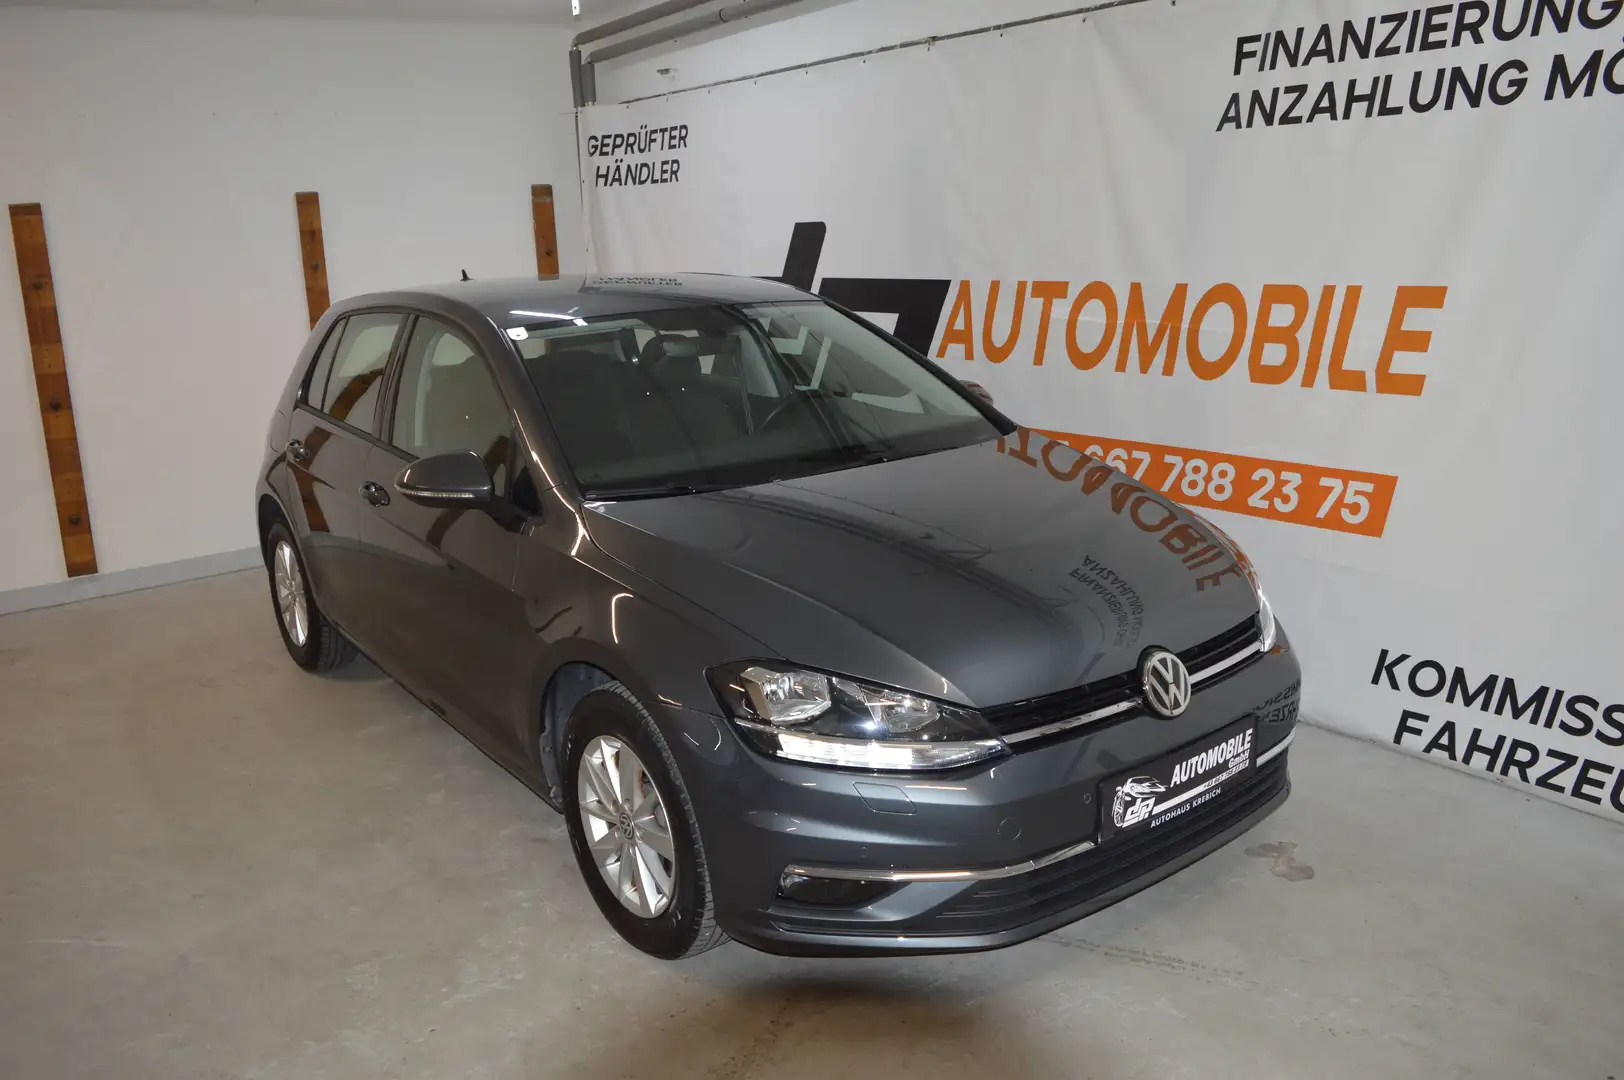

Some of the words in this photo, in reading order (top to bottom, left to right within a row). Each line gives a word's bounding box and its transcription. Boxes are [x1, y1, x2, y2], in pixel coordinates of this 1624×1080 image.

[1233, 0, 1623, 76] FINANZIERUNG
[1216, 59, 1529, 132] ANZAHLUNG
[587, 124, 689, 157] GEPRÜFTER
[595, 158, 681, 187] HÄNDLER
[935, 279, 1448, 397] AUTOMOBILE
[1159, 454, 1236, 502] 788
[1247, 468, 1302, 513] 23
[1314, 476, 1375, 525] 75
[1370, 648, 1624, 747] KOMMISS
[1170, 728, 1253, 788] AUTOMOBILE
[1228, 749, 1250, 769] GmbH
[1150, 803, 1191, 829] AUTOHAUS
[1192, 787, 1221, 808] KREBICH
